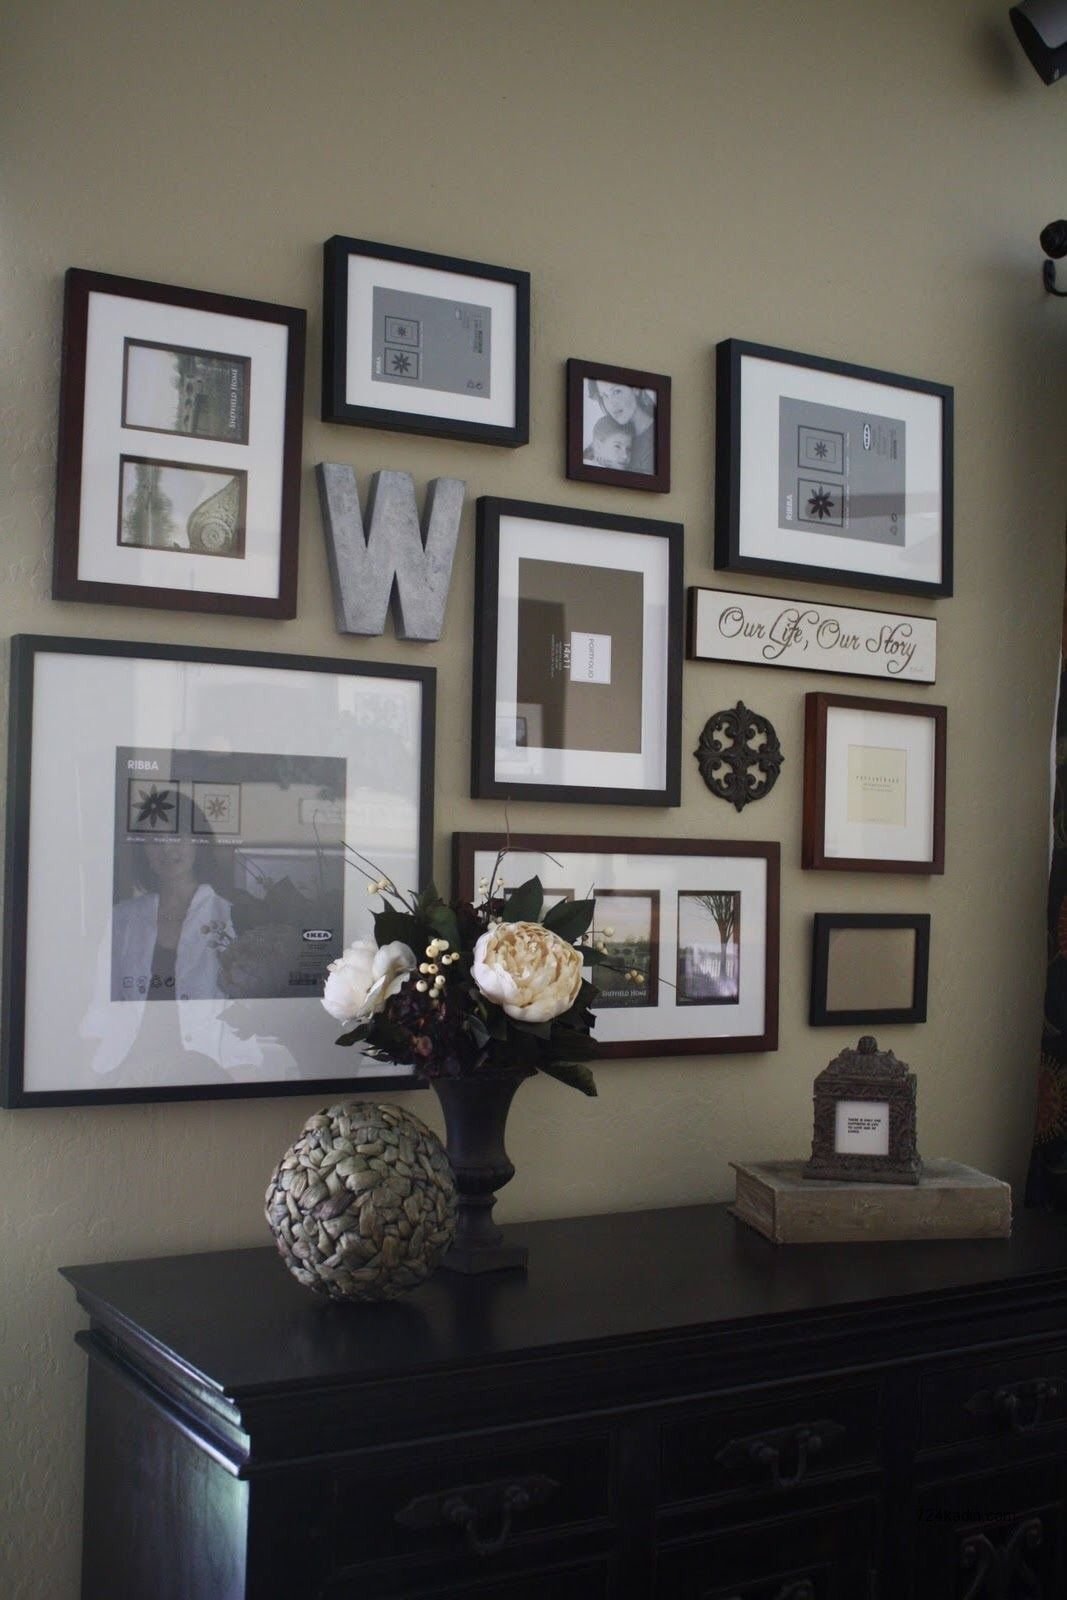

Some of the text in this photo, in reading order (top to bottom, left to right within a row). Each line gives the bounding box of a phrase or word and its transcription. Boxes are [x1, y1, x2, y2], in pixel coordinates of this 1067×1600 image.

[315, 462, 466, 641] W
[719, 606, 765, 638] Our
[816, 619, 859, 649] Our
[865, 623, 917, 674] Story
[127, 759, 159, 770] RIBBA
[305, 931, 330, 939] IKEA
